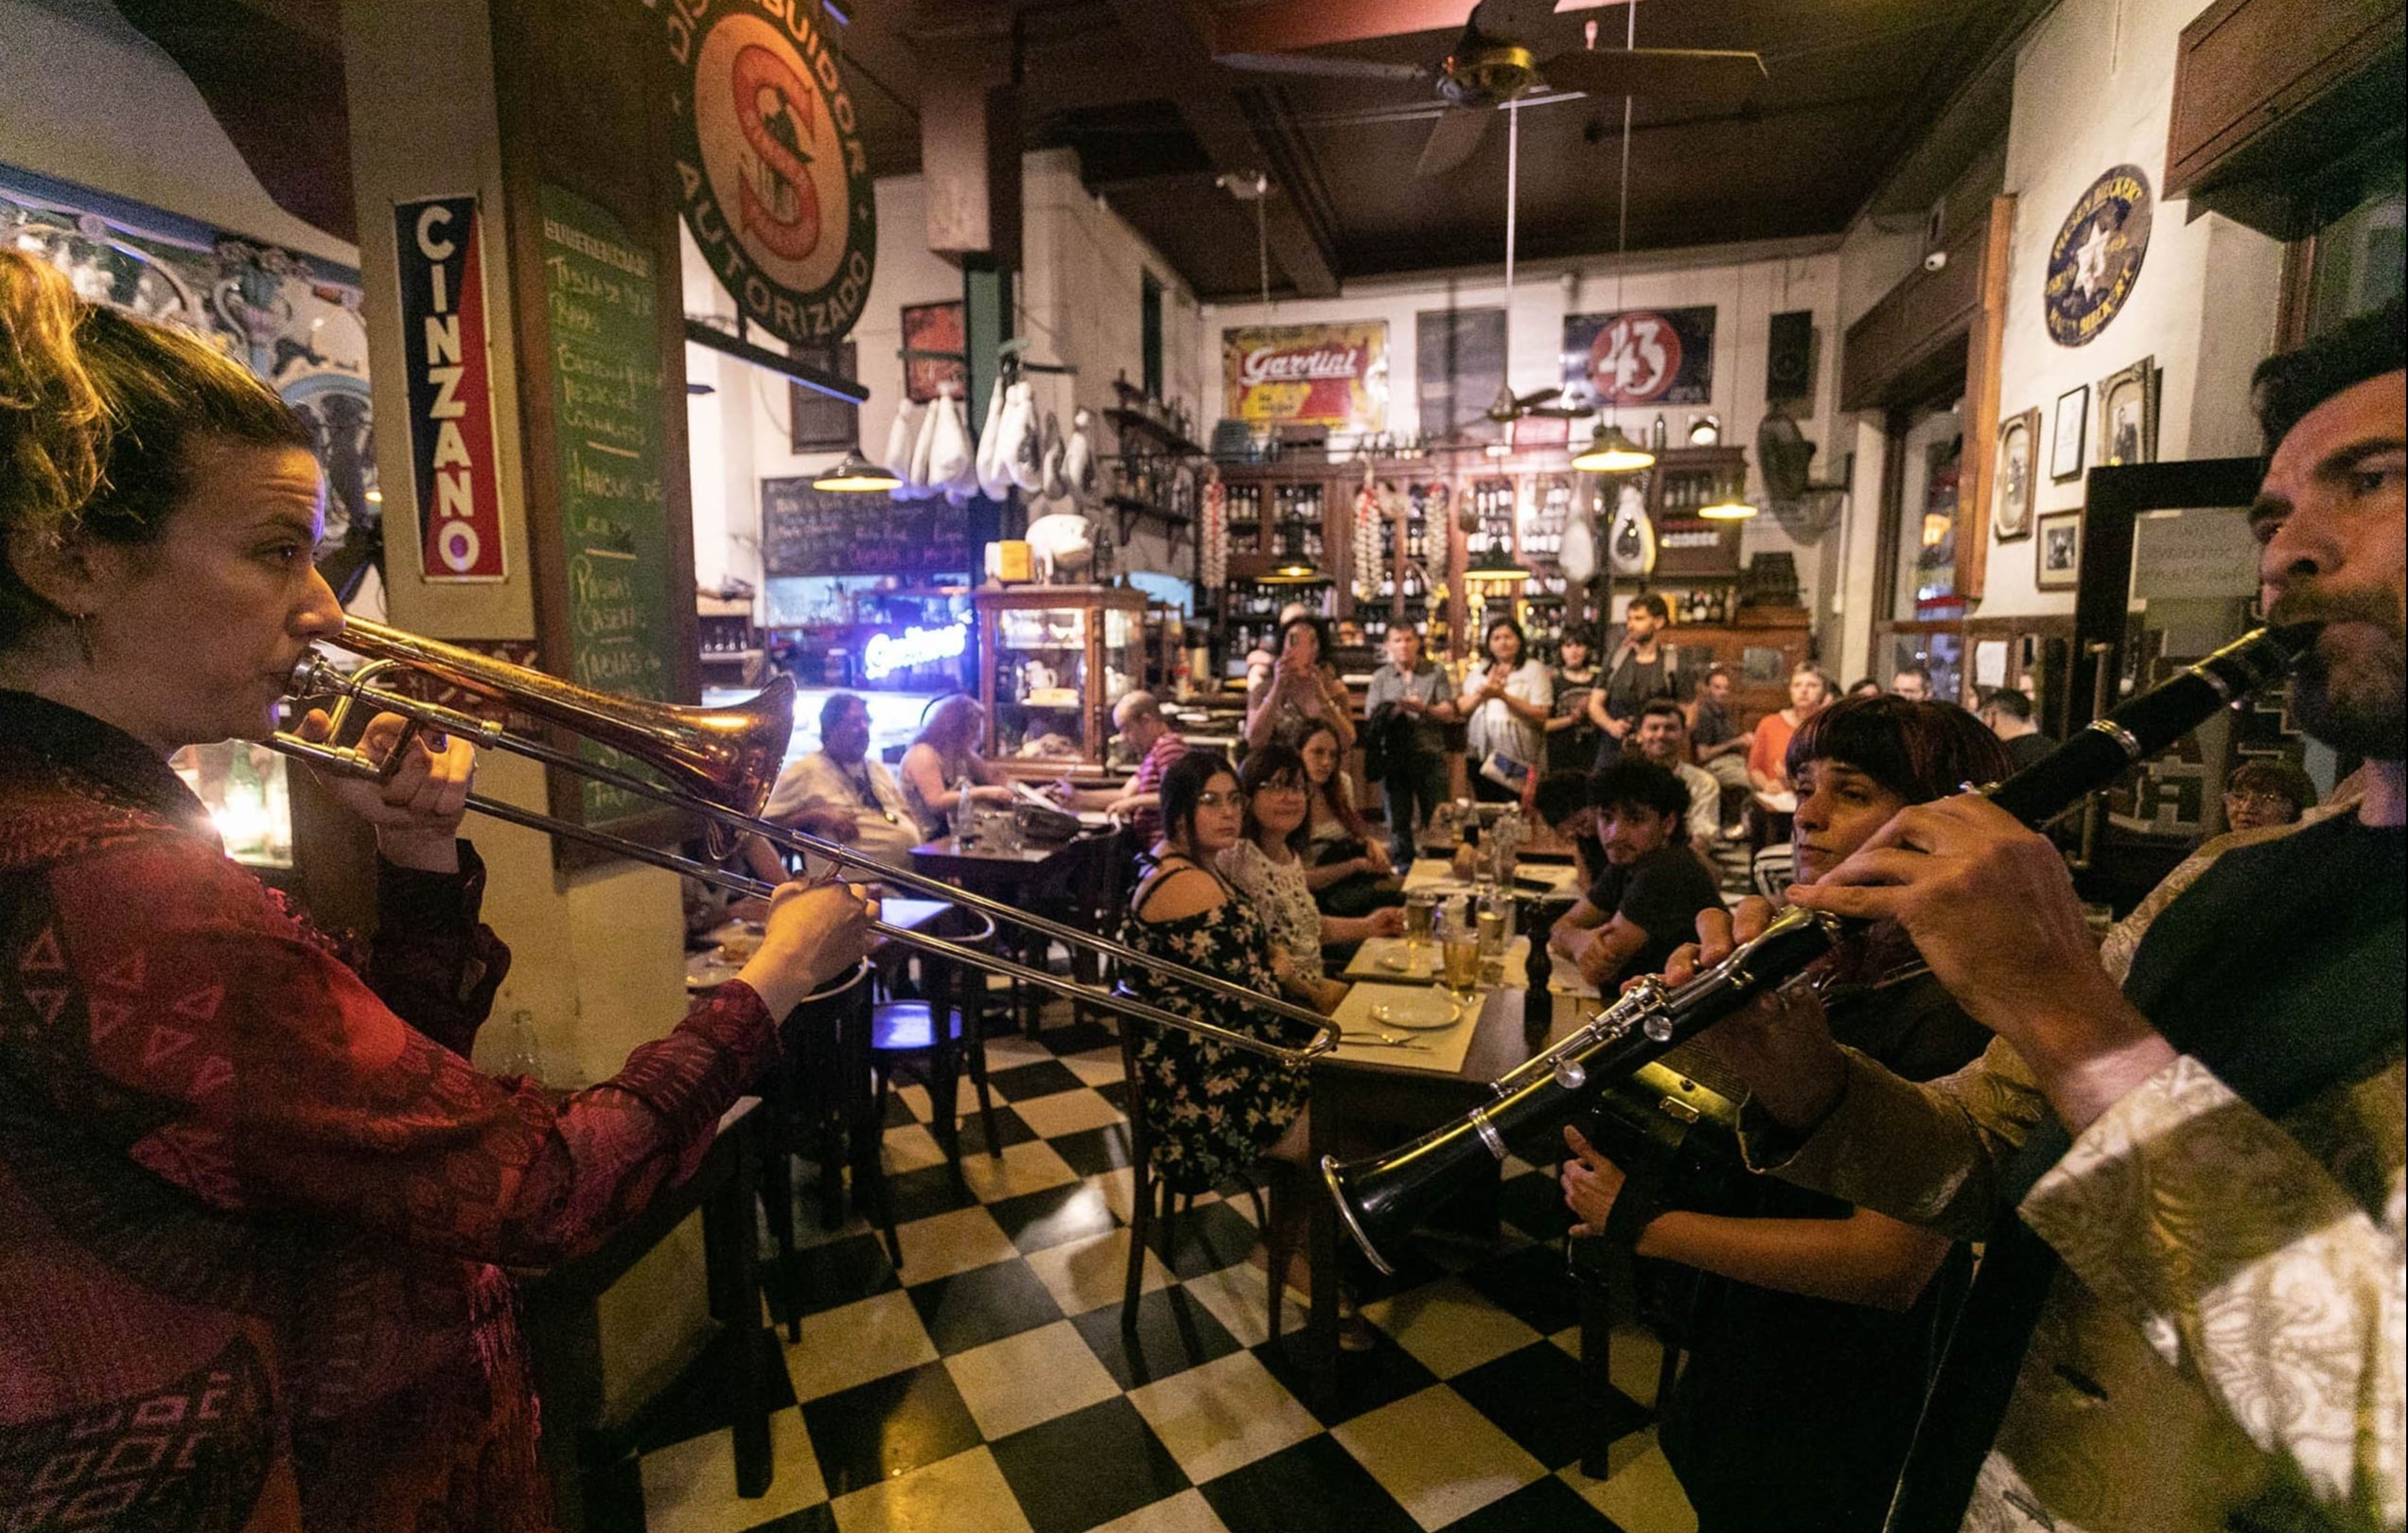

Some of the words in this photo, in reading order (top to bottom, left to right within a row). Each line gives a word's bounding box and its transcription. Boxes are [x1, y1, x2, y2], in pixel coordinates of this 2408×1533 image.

[666, 0, 866, 175] DISBUIDOR
[675, 160, 870, 335] AUTORIZADO
[416, 205, 480, 572] CINZANO
[1598, 321, 1666, 396] 43
